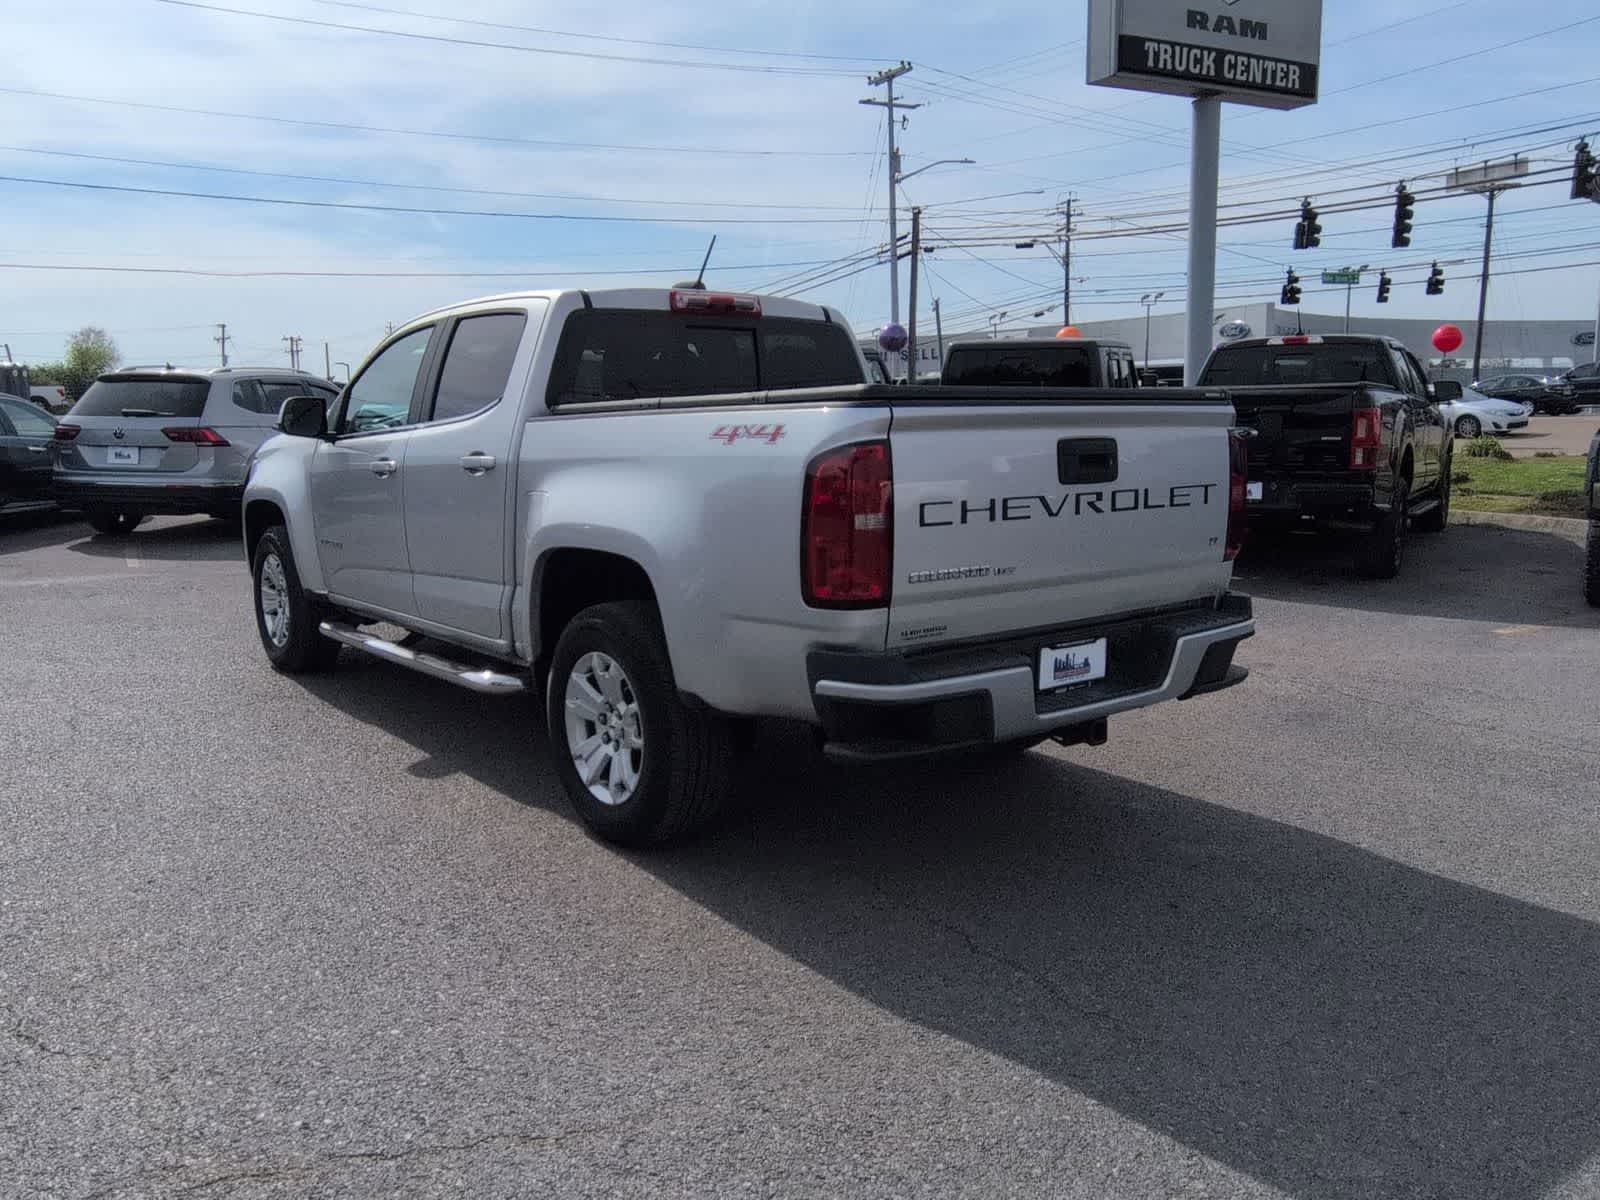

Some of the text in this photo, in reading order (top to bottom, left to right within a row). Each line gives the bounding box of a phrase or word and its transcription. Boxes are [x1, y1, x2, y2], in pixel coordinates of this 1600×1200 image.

[1186, 9, 1268, 40] RAM
[1144, 40, 1301, 89] TRUCK CENTER
[919, 483, 1217, 527] CHEVROLET
